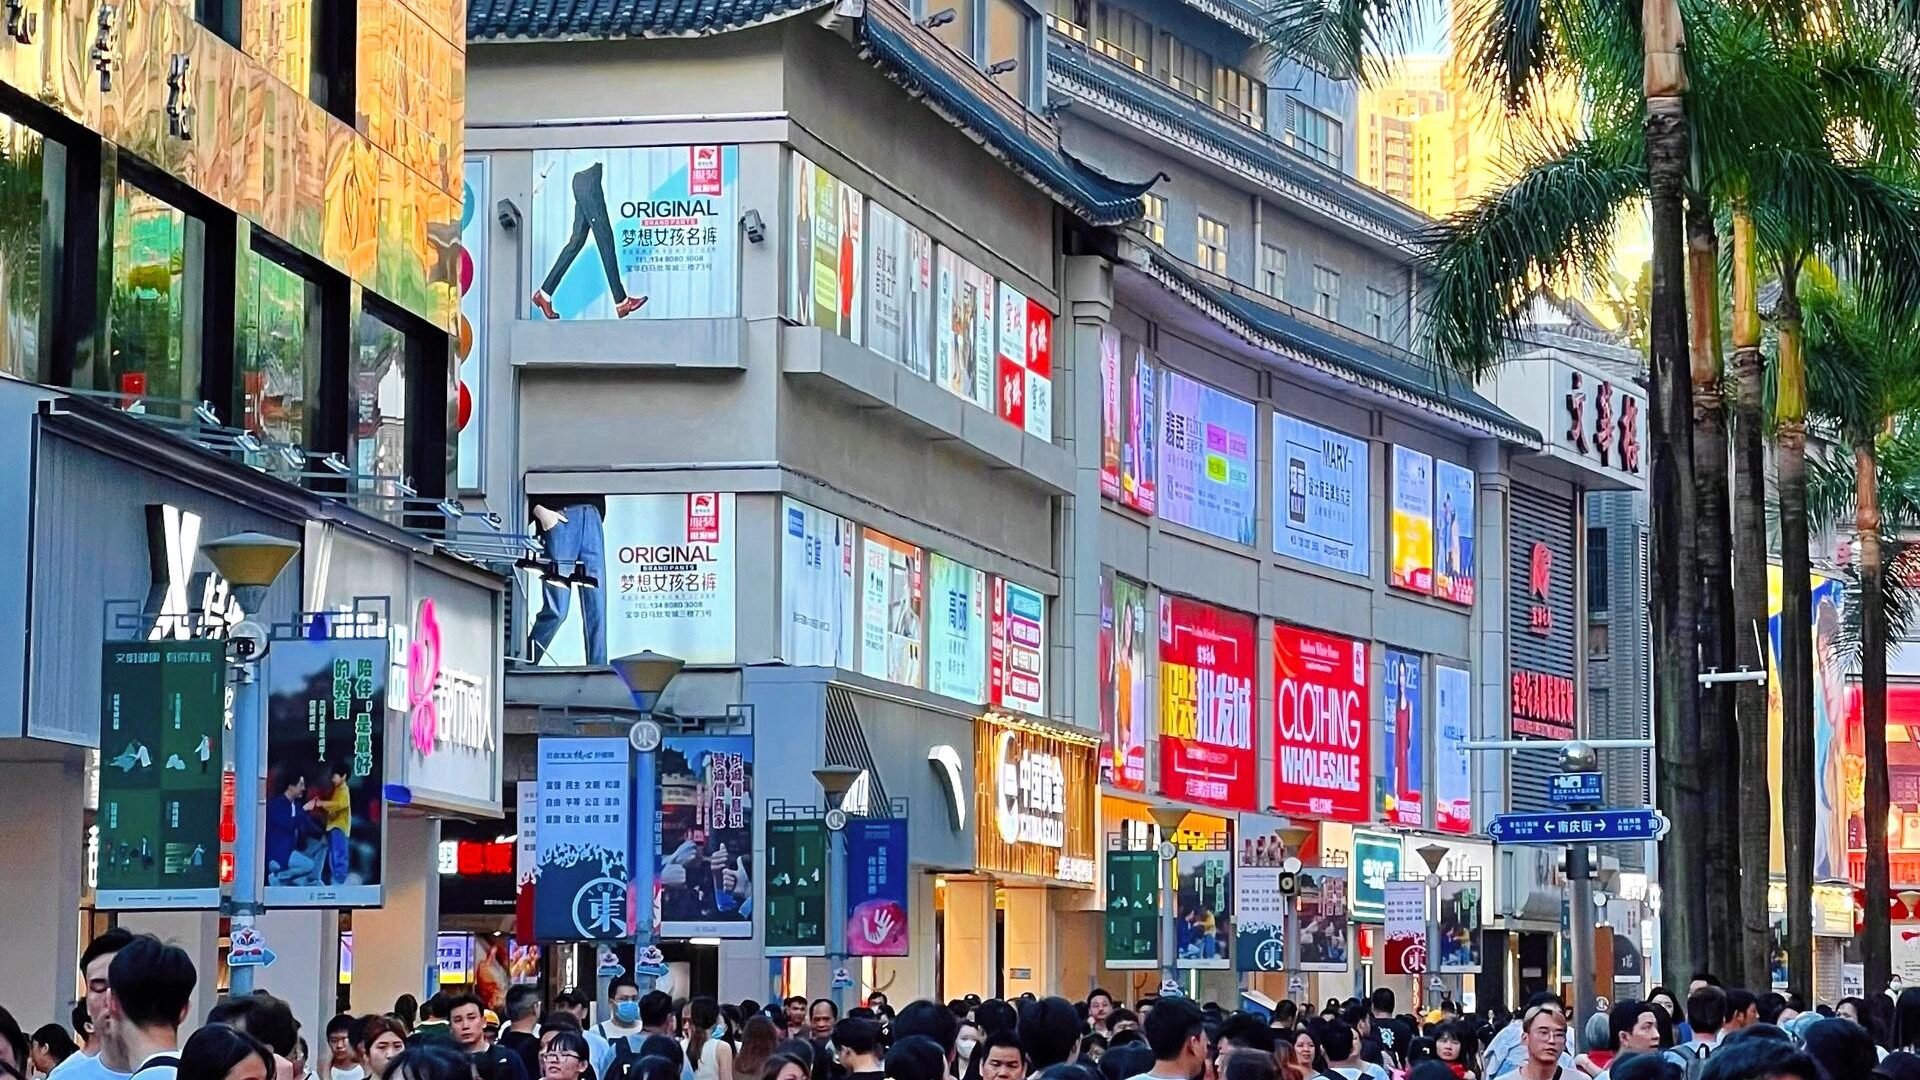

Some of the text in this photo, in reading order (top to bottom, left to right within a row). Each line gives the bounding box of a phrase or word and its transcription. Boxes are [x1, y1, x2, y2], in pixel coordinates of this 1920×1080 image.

[620, 200, 718, 218] ORIGINAL
[621, 227, 718, 248] 梦想女孩名裤
[1322, 439, 1349, 473] MARY
[618, 545, 718, 563] ORIGINAL
[620, 573, 717, 593] 梦想女孩名裤
[333, 658, 350, 720] 的教育
[1160, 660, 1251, 750] 服装批发城
[1278, 678, 1361, 749] CLOTHING
[1280, 745, 1360, 792] WHOLESALE
[584, 797, 599, 806] 公正
[1493, 823, 1503, 834] 北
[1558, 820, 1593, 833] 南庆街
[1648, 818, 1658, 829] 南
